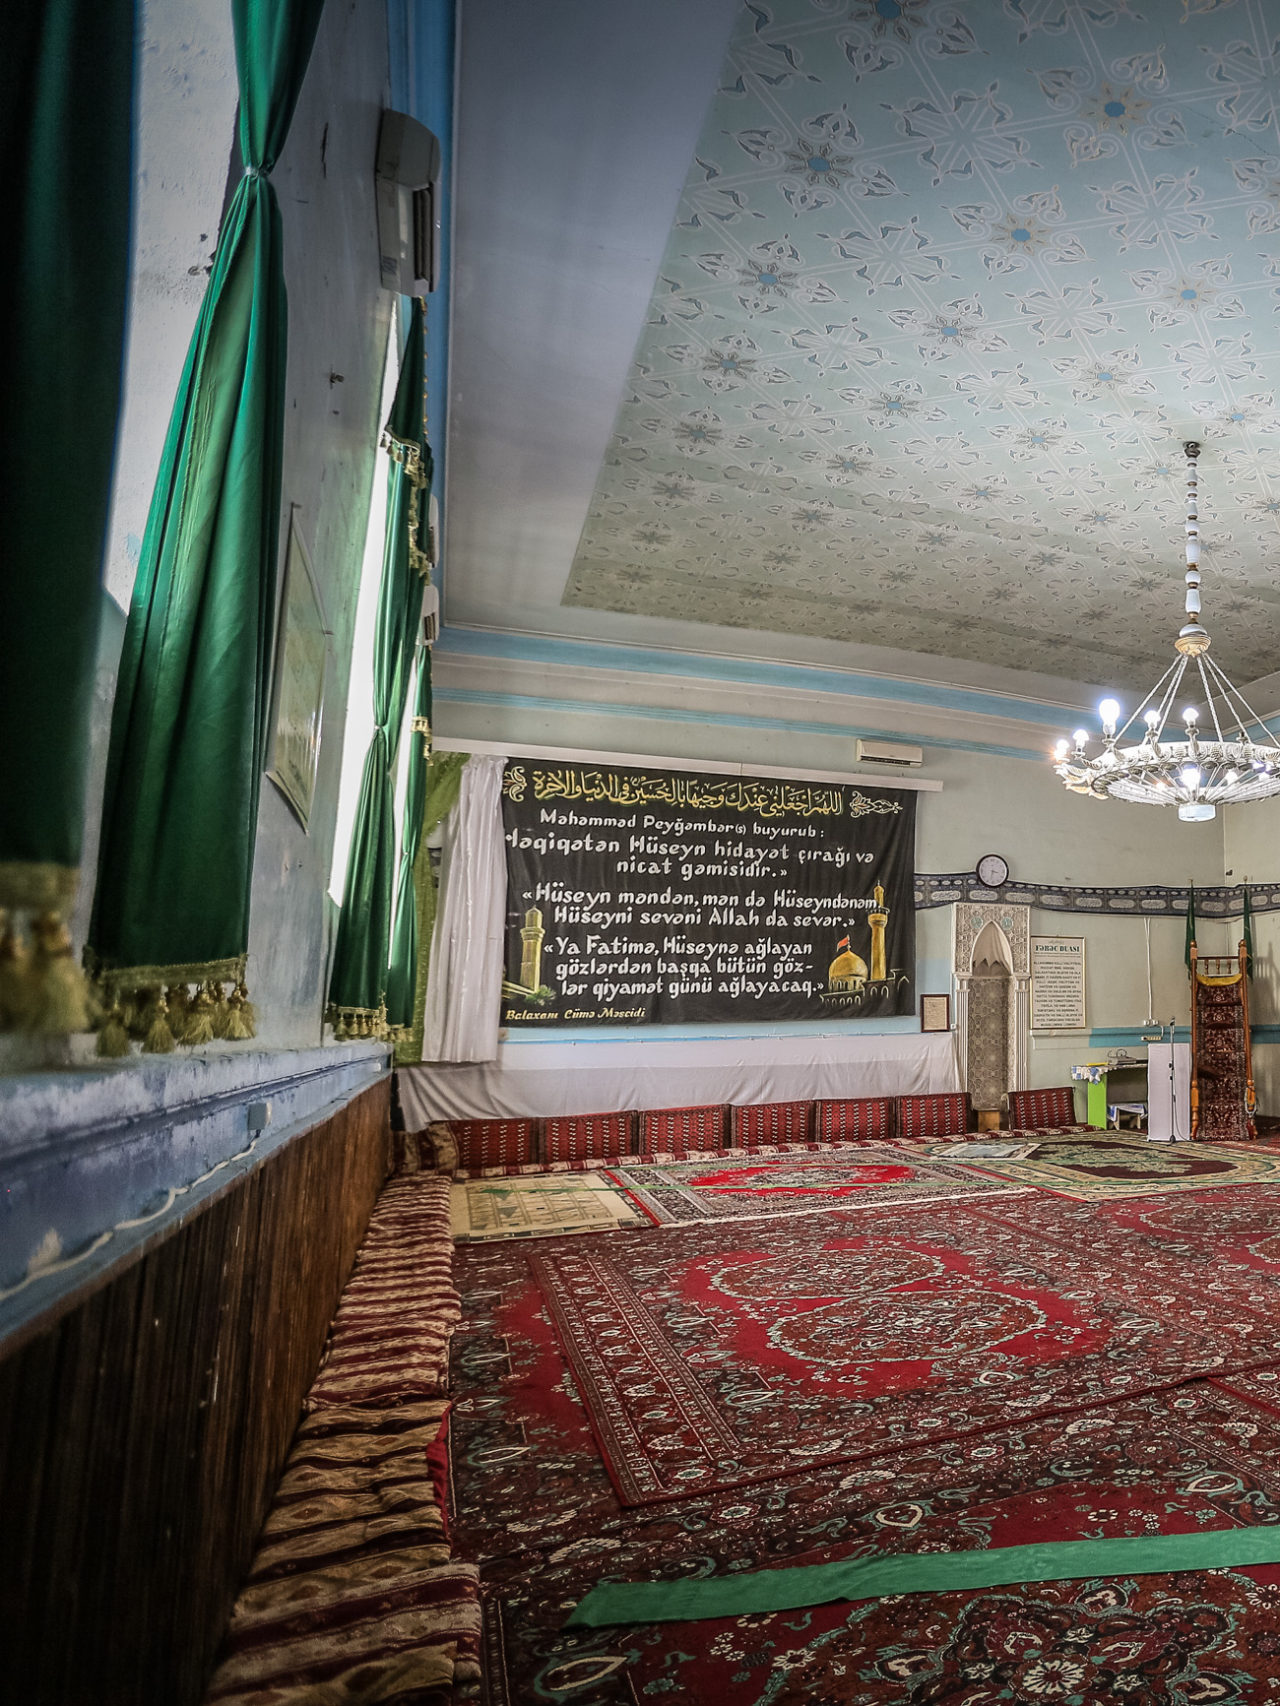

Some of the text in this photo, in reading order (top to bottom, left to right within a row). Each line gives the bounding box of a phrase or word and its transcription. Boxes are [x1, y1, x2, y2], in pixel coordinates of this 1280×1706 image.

[540, 808, 637, 828] Məhəmməd
[629, 834, 706, 861] Hüseyn
[714, 840, 789, 866] hidayət
[798, 846, 850, 868] çırağı
[856, 851, 875, 864] və
[616, 855, 673, 874] nicat
[618, 886, 700, 907] məndən,
[702, 893, 739, 906] mən
[744, 889, 766, 907] də
[554, 905, 633, 930] Hüseyni
[639, 907, 702, 925] sevəni
[708, 907, 760, 927] Allah
[765, 911, 789, 927] da
[586, 934, 660, 956] Fatimə,
[663, 935, 739, 961] Hüseynə
[744, 937, 813, 961] ağlayan
[555, 956, 814, 981] gözlərdən başqa bütün göz-
[561, 980, 588, 996] lər
[592, 976, 664, 1002] qiyamət
[668, 977, 713, 999] günü
[564, 1008, 596, 1019] Cümə
[597, 1007, 646, 1019] Məscidi
